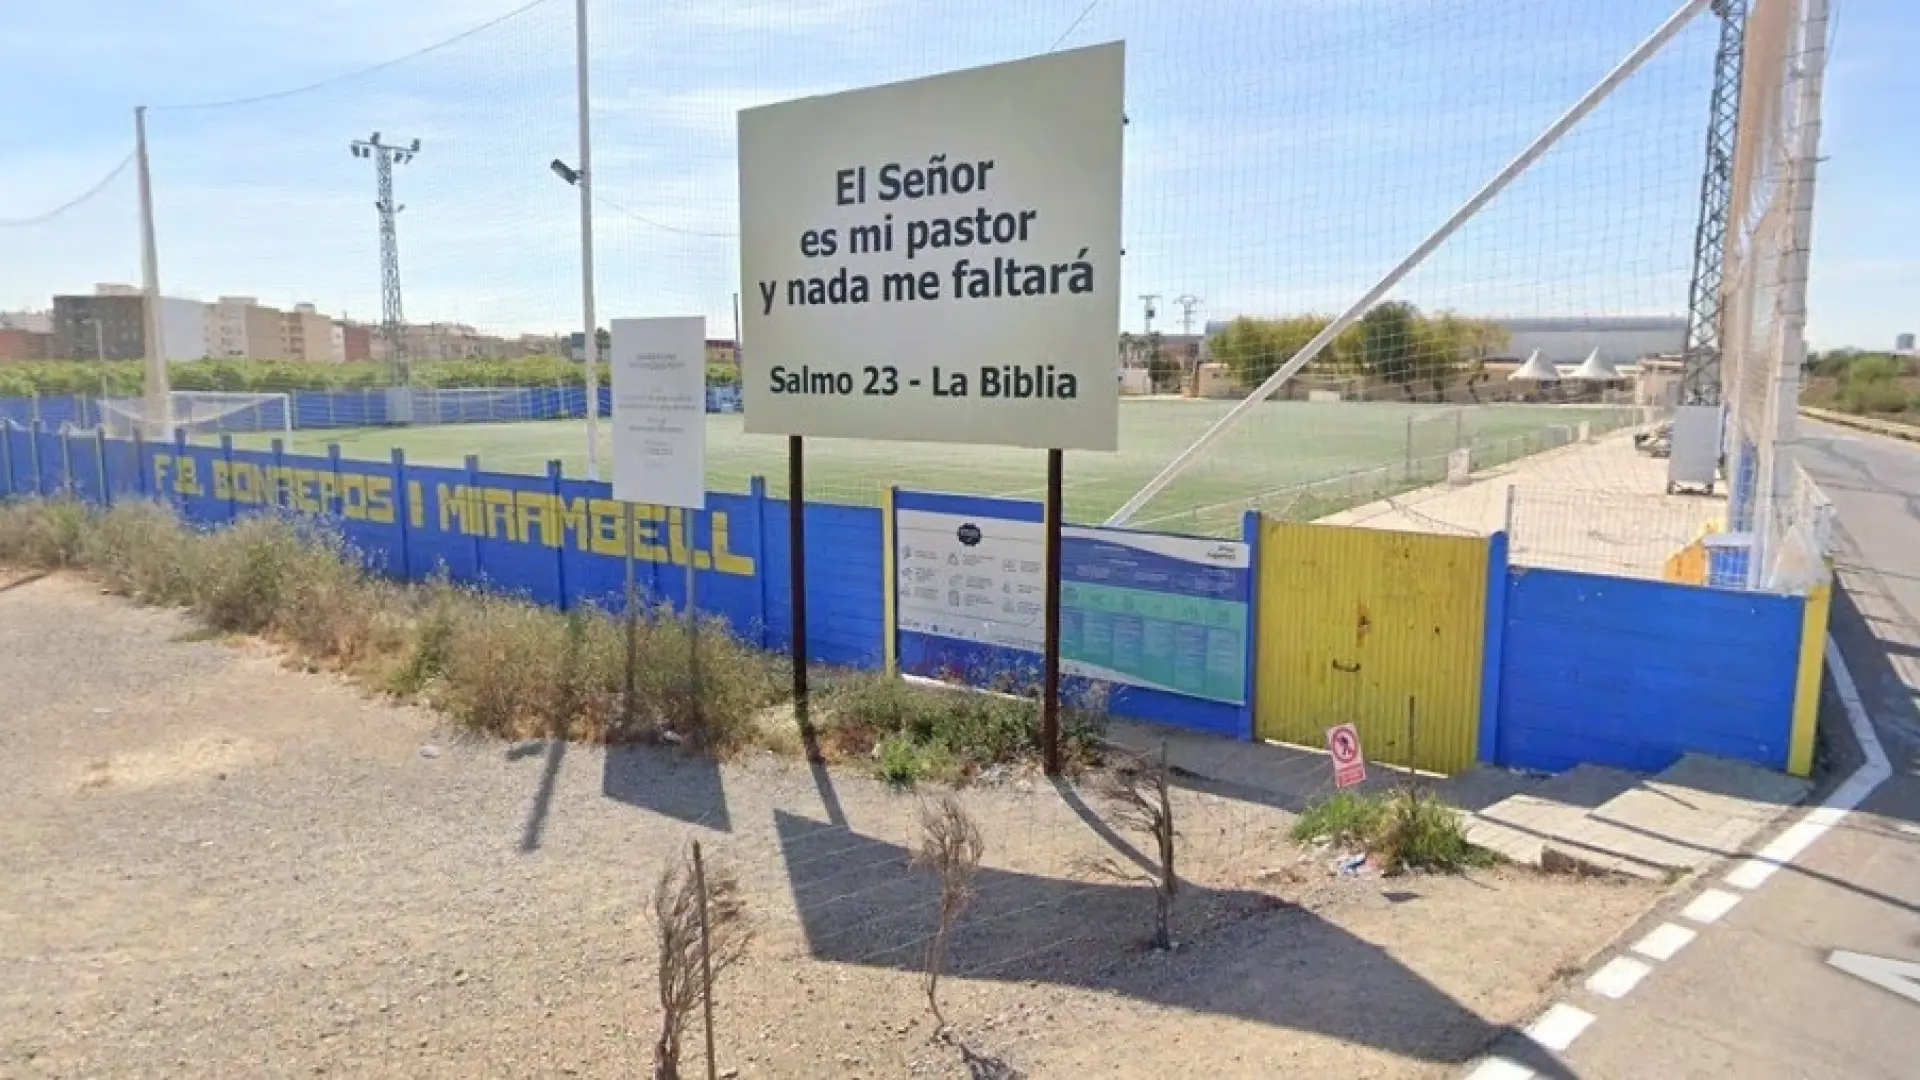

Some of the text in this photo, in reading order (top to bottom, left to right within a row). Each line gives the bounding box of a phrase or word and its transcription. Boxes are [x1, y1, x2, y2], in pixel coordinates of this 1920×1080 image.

[837, 154, 994, 206] El Señor
[800, 207, 1037, 259] es mi pastor
[758, 247, 1094, 316] y nada me faltará
[769, 364, 854, 396] Salmo
[862, 365, 899, 396] 23
[932, 365, 968, 398] La
[979, 364, 1077, 400] Biblia
[407, 480, 425, 529] I
